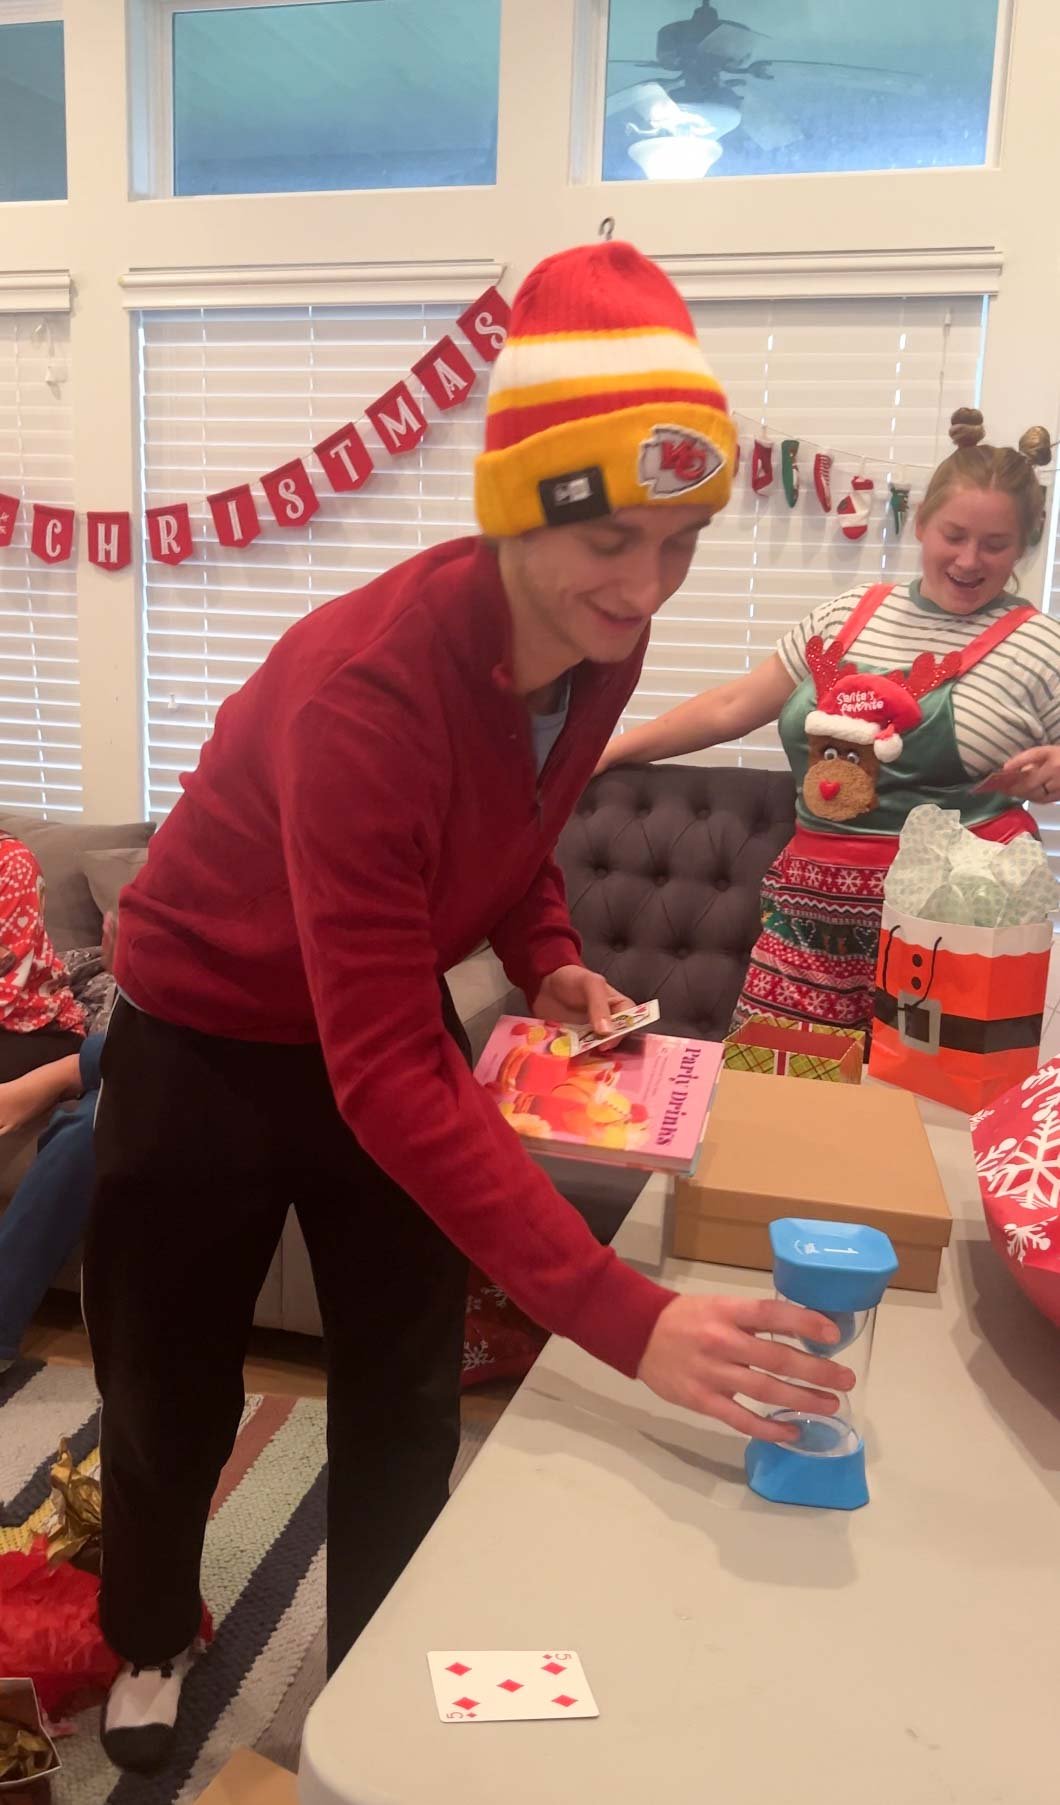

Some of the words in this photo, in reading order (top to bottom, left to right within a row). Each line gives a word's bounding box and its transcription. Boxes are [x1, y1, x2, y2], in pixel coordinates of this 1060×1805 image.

[45, 311, 508, 564] CHRISTMAS
[661, 440, 707, 481] KC
[836, 690, 875, 705] Santa's
[840, 699, 884, 717] favorite
[668, 1048, 701, 1088] Party
[656, 1091, 688, 1145] Drinks
[555, 1653, 572, 1661] 5
[446, 1711, 464, 1719] 5
